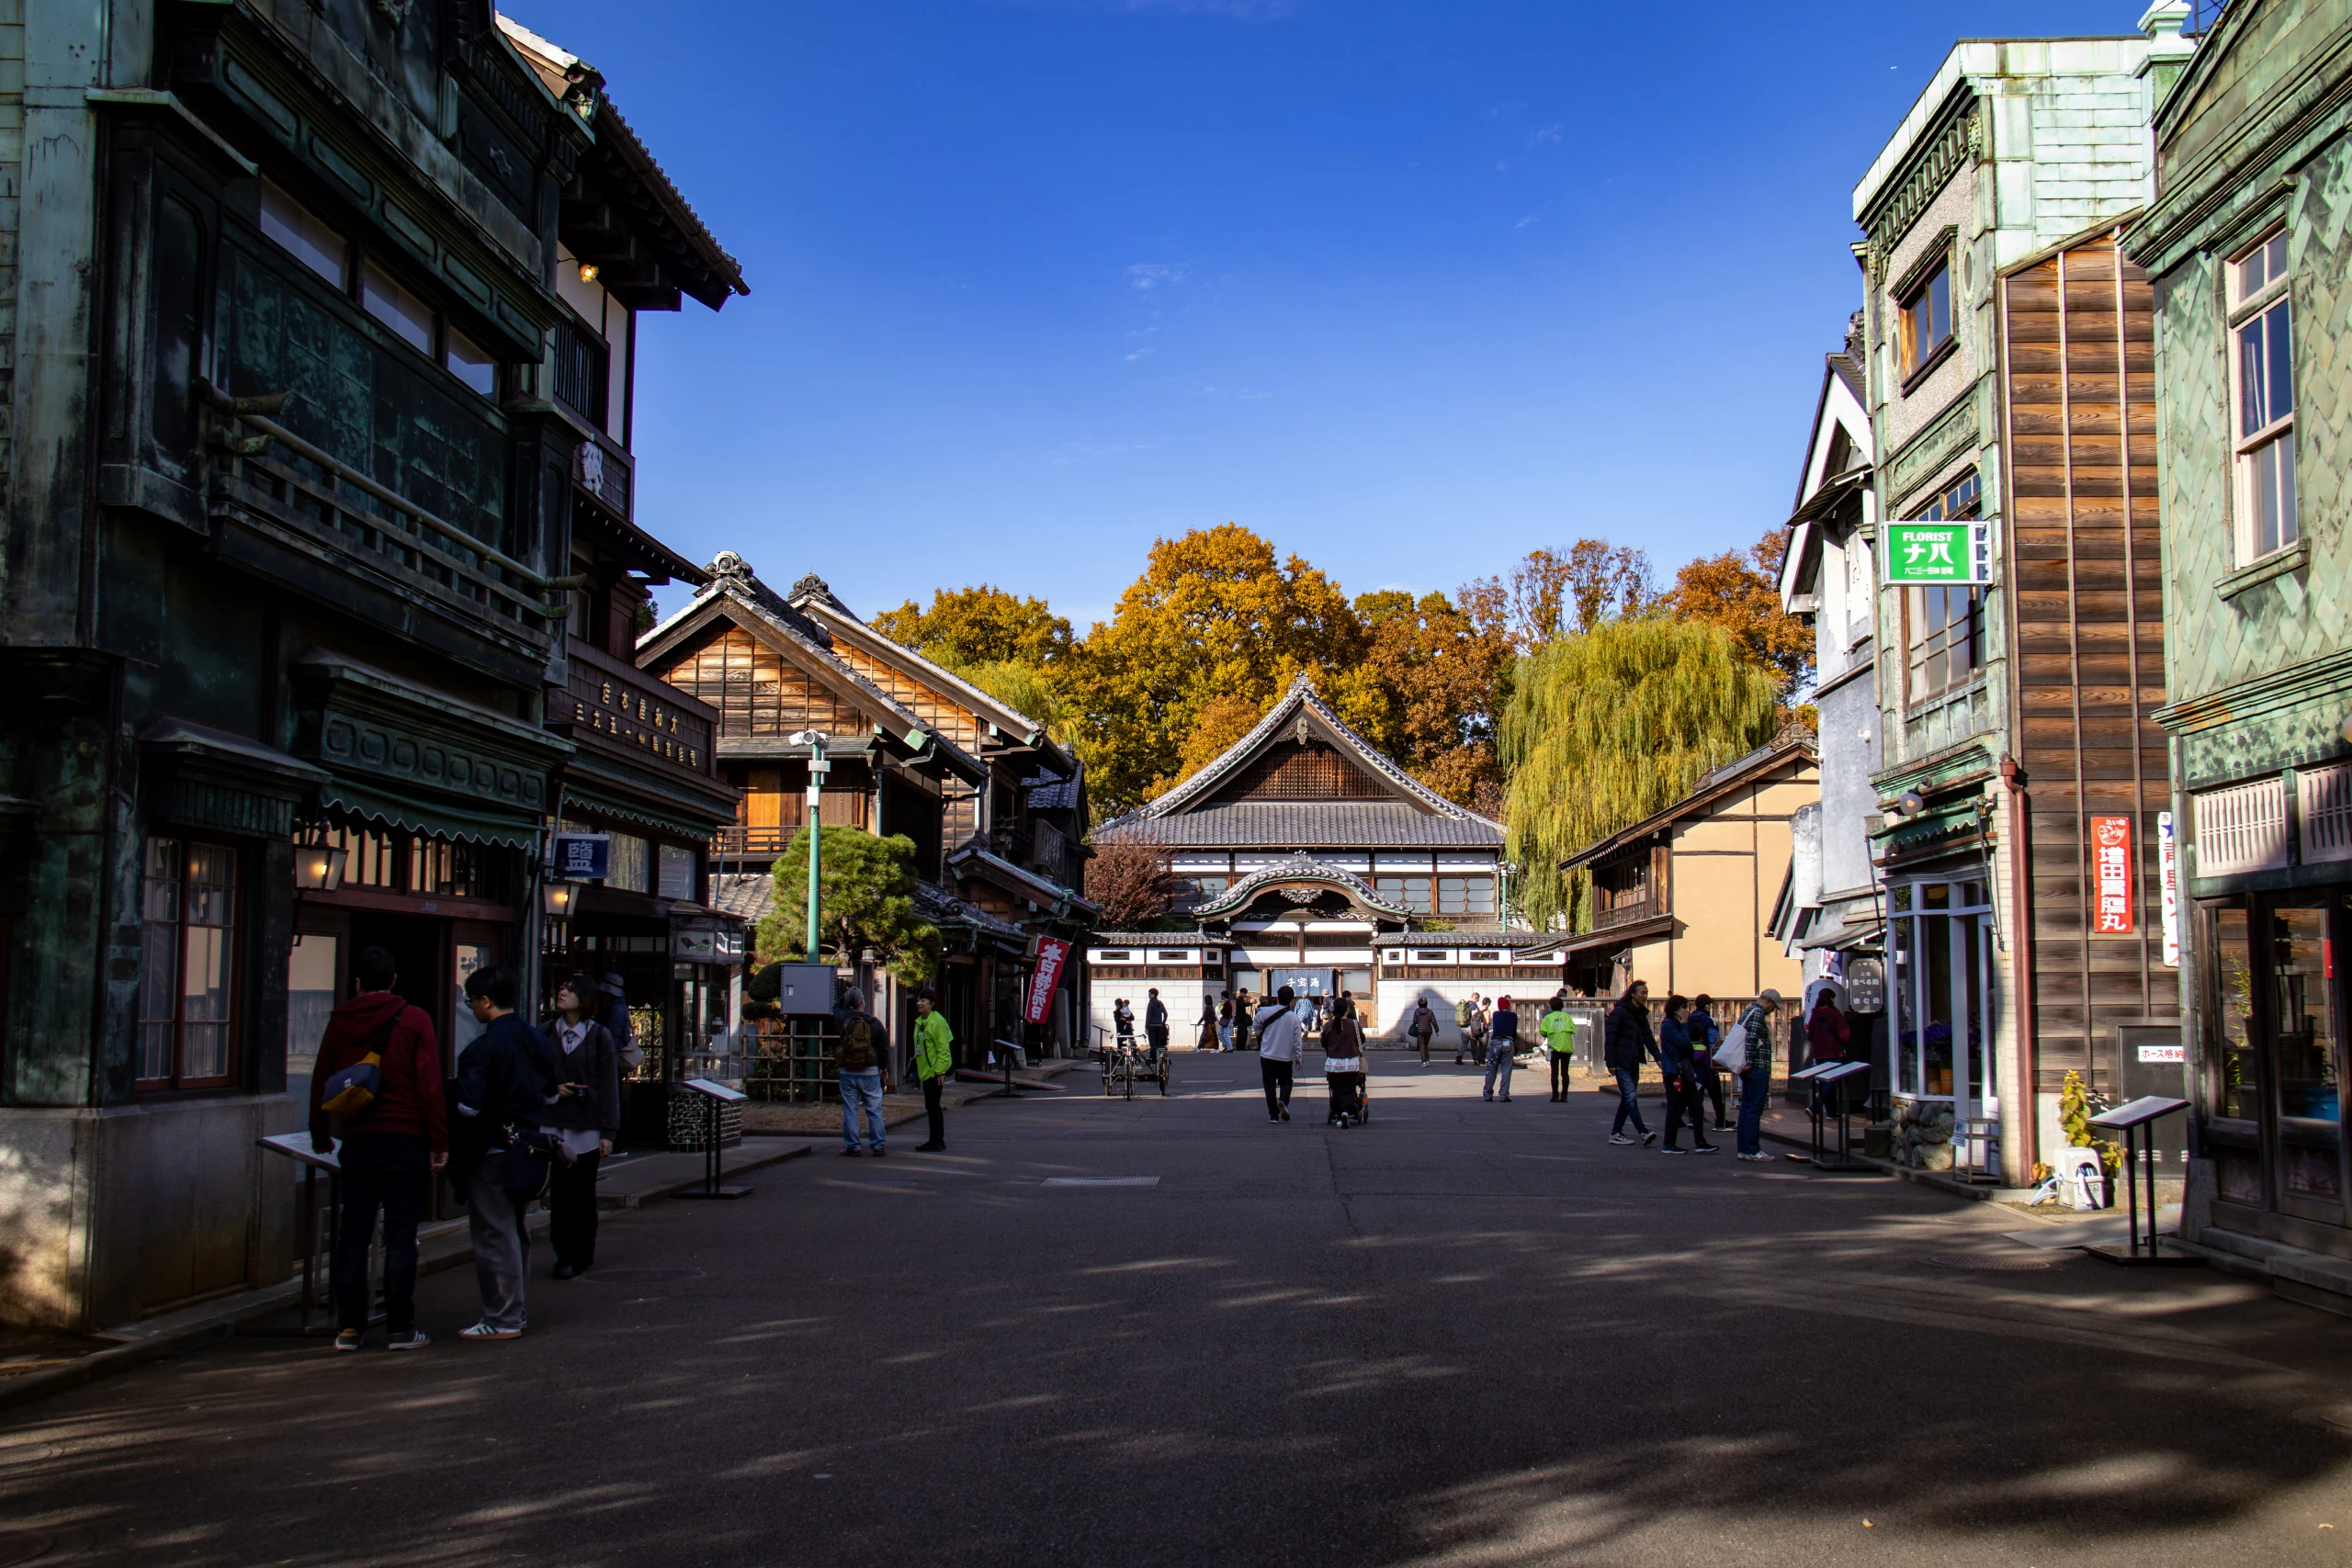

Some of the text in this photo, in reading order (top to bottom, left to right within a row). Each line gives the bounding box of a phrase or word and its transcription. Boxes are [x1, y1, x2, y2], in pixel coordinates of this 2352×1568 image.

[1903, 532, 1953, 542] FLORIST
[1031, 943, 1063, 1021] 本日特売日
[1286, 976, 1320, 987] 子宝湯
